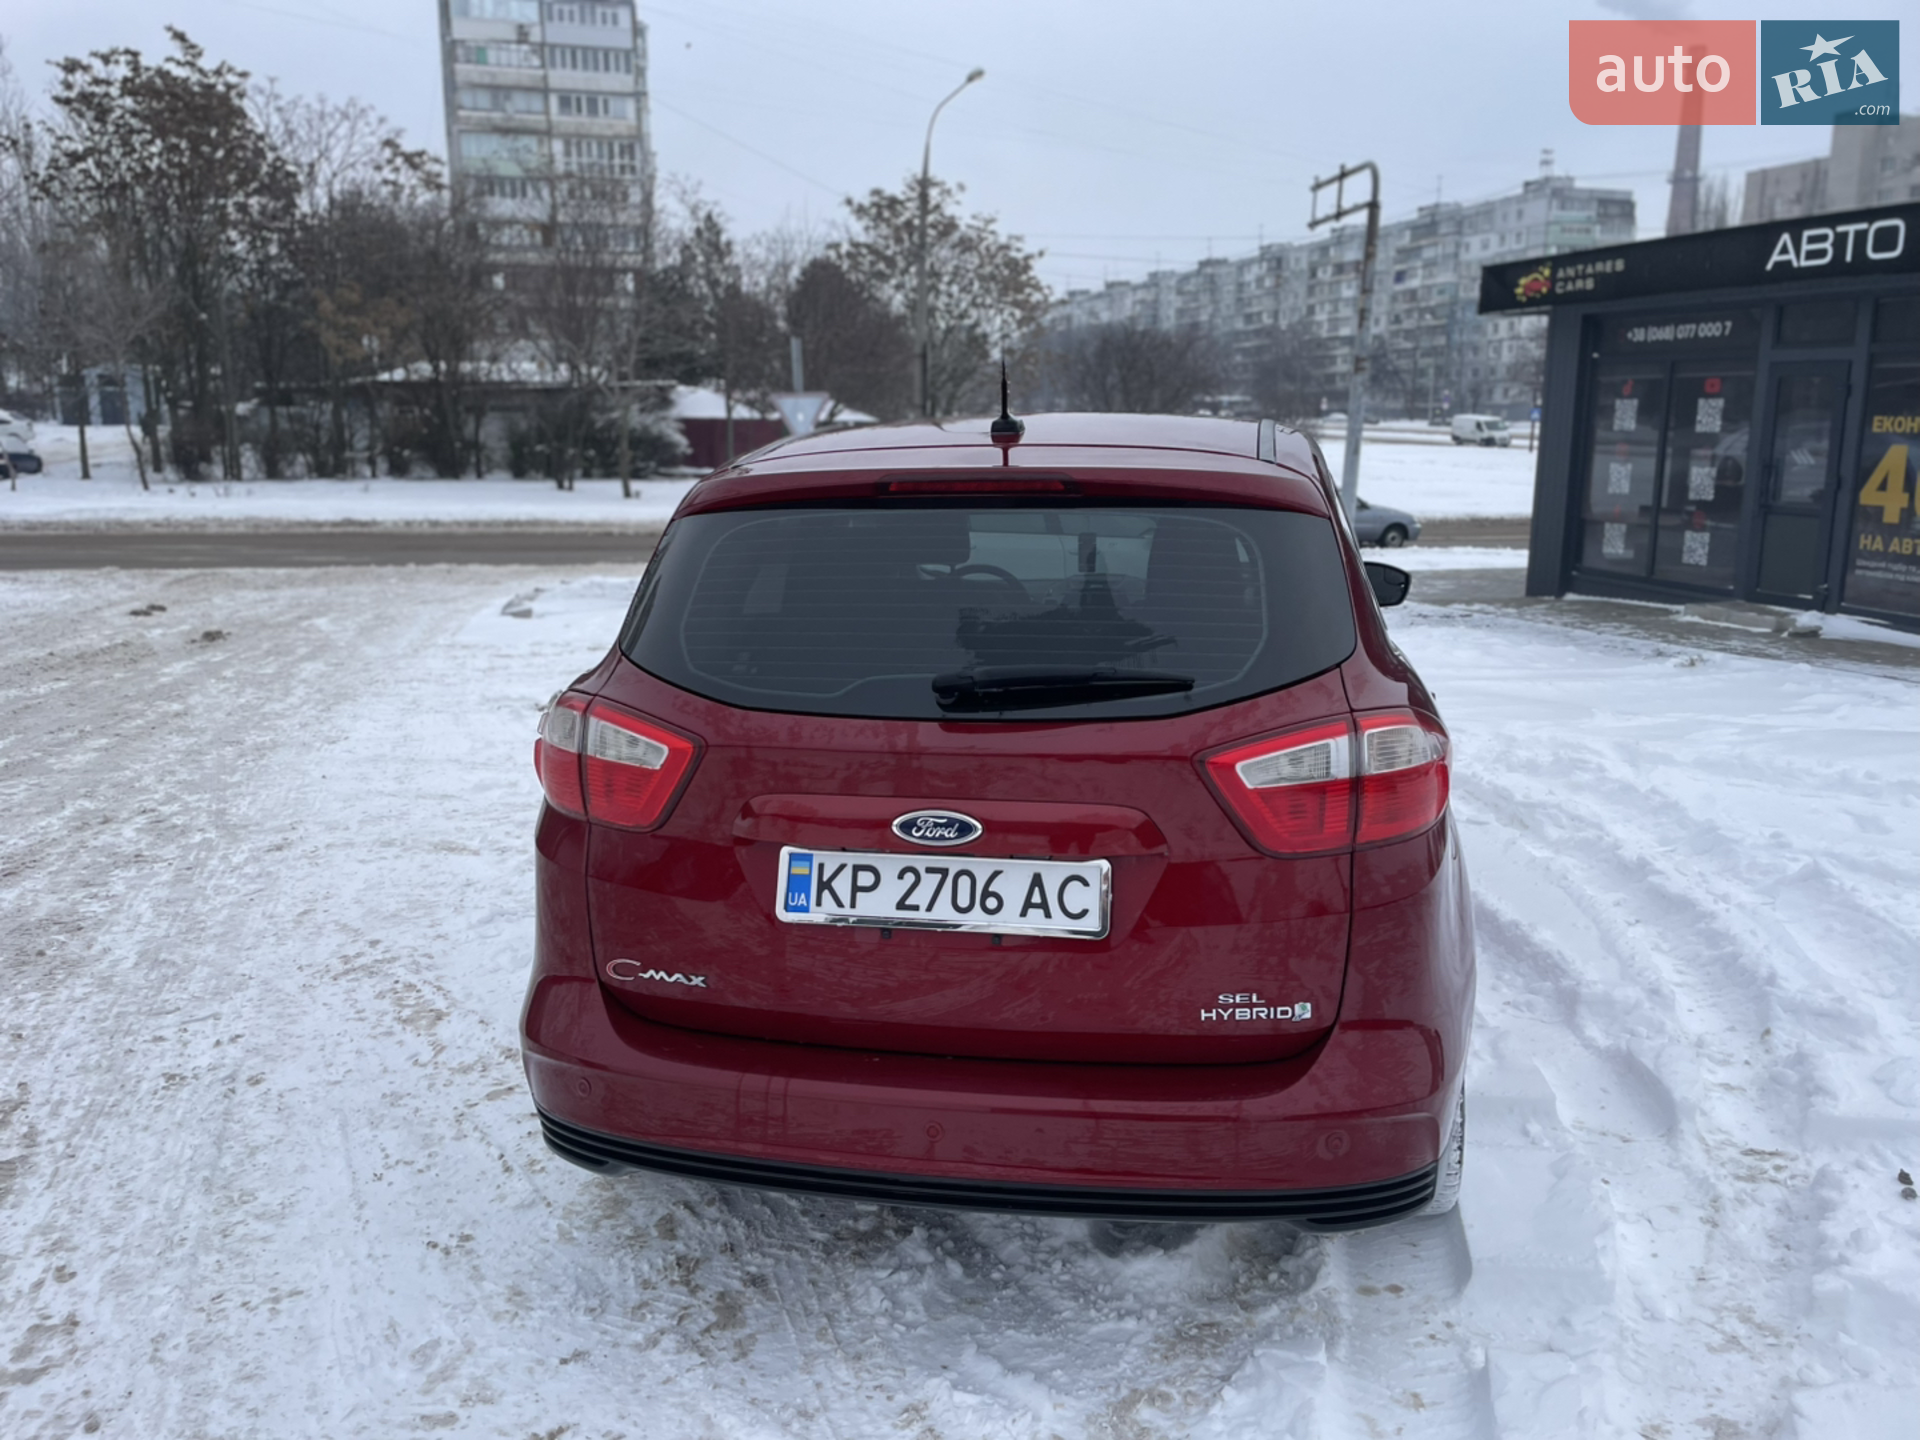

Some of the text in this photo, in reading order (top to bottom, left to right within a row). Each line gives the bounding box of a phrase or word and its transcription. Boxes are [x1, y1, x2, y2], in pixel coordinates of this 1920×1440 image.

[1765, 218, 1906, 271] АВТО
[1556, 258, 1625, 279] ANTARES
[1555, 277, 1595, 294] CARS
[1676, 323, 1697, 339] 077
[1698, 320, 1722, 338] 000
[1724, 320, 1733, 336] 7
[1872, 415, 1920, 433] ЕКОН
[1859, 444, 1920, 524] 4
[1859, 533, 1884, 552] НА
[911, 816, 959, 839] Ford
[788, 892, 808, 908] UA
[815, 862, 1091, 920] KP 2706 AC
[1218, 992, 1266, 1004] SEL
[1200, 1006, 1292, 1021] HYBRID
